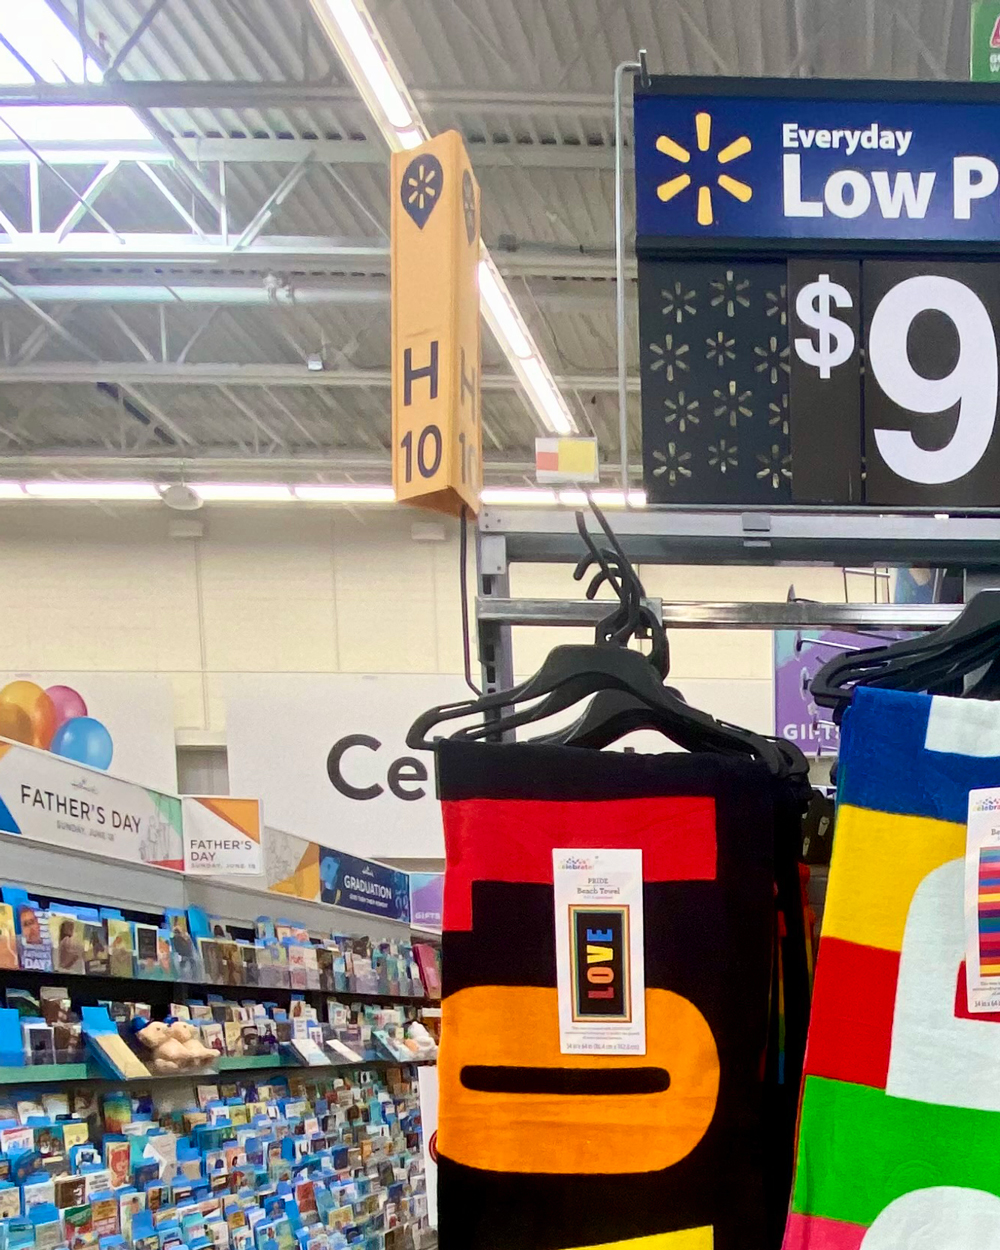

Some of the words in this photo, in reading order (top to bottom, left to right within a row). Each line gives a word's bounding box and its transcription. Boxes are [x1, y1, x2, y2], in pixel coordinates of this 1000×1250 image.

[783, 123, 912, 156] Everyday
[783, 153, 937, 219] Low
[404, 341, 439, 406] H
[400, 424, 443, 484] 10
[20, 784, 106, 825] FATHER'S
[112, 810, 142, 834] DAY
[190, 839, 252, 850] FATHER'S
[190, 851, 216, 862] DAY
[343, 874, 393, 900] GRADUATION
[577, 887, 599, 895] Beach
[599, 887, 620, 895] Towel
[414, 911, 441, 920] GIFTS
[586, 928, 615, 999] LOVE
